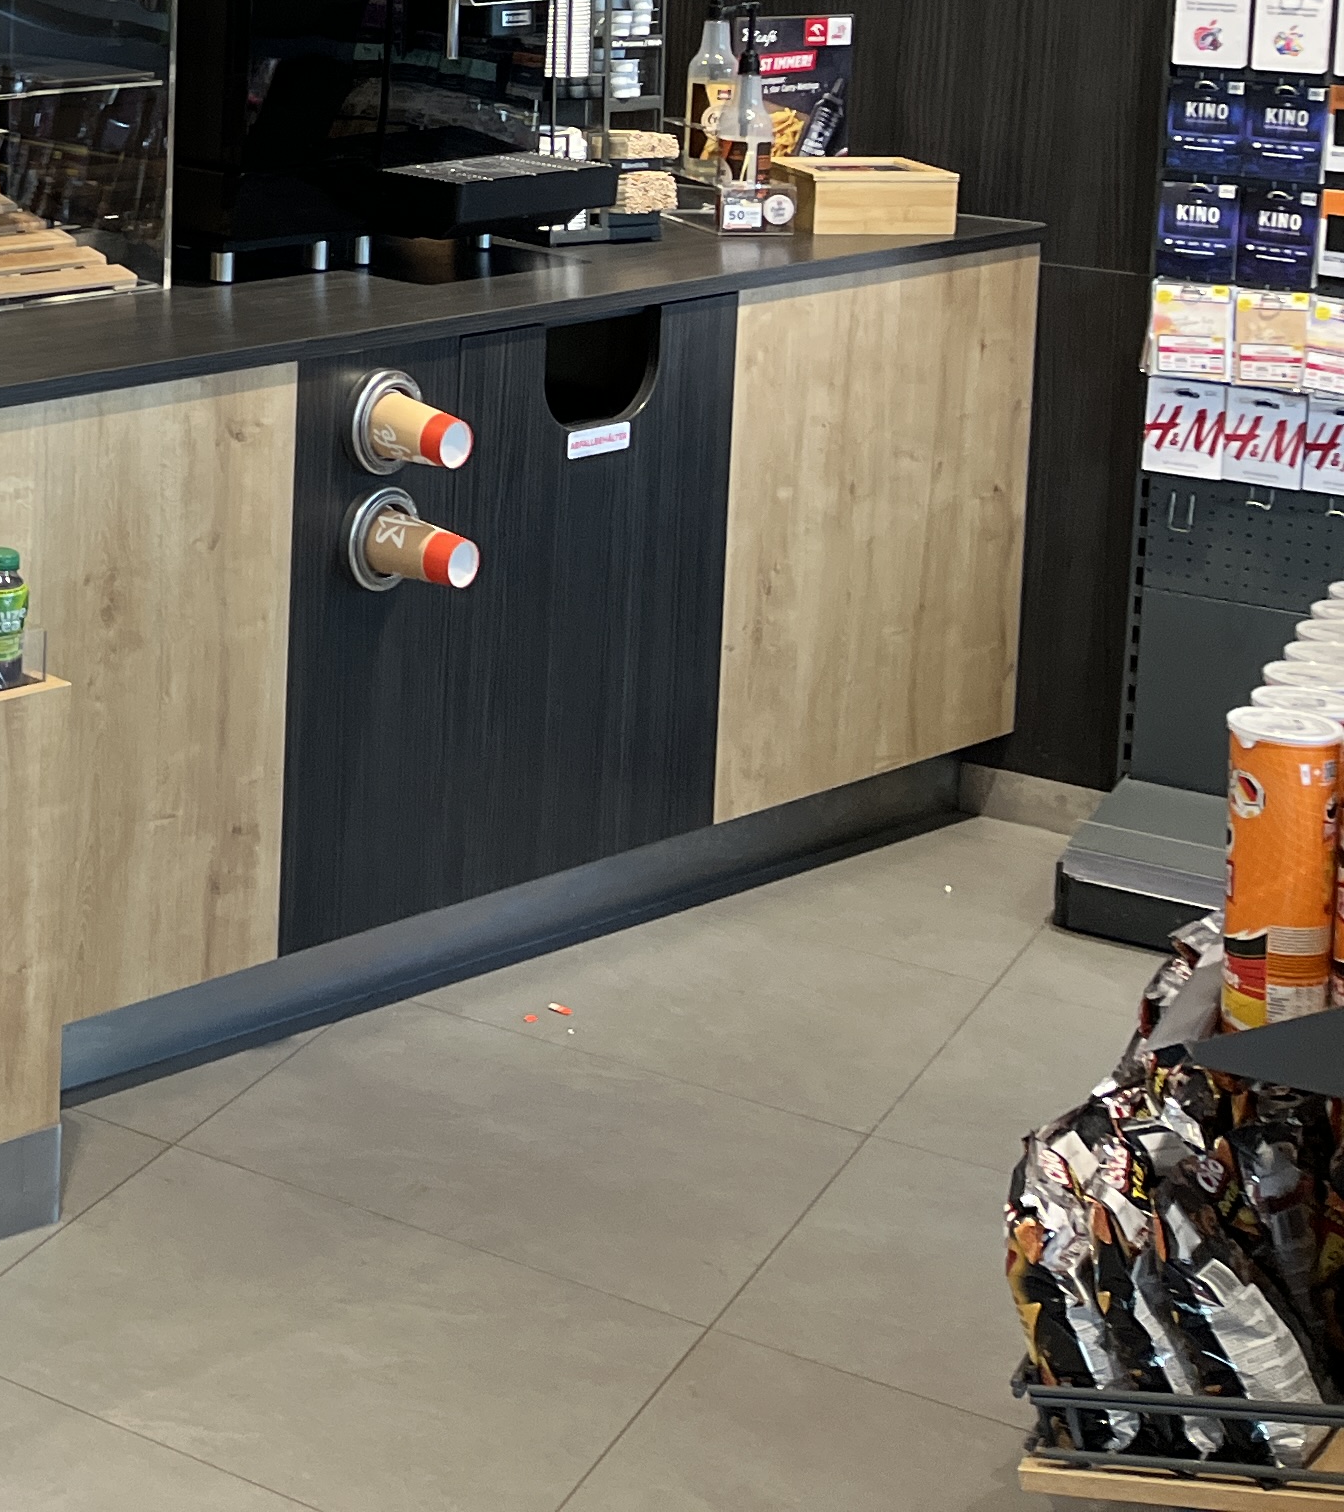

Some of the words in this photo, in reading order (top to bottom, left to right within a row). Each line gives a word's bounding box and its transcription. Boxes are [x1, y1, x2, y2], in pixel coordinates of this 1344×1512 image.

[774, 53, 814, 71] IMMER!
[1264, 107, 1309, 126] KINO
[1176, 204, 1220, 223] KINO
[1258, 210, 1302, 230] KINO
[1144, 403, 1226, 458] H&M
[1224, 413, 1307, 469] H&M
